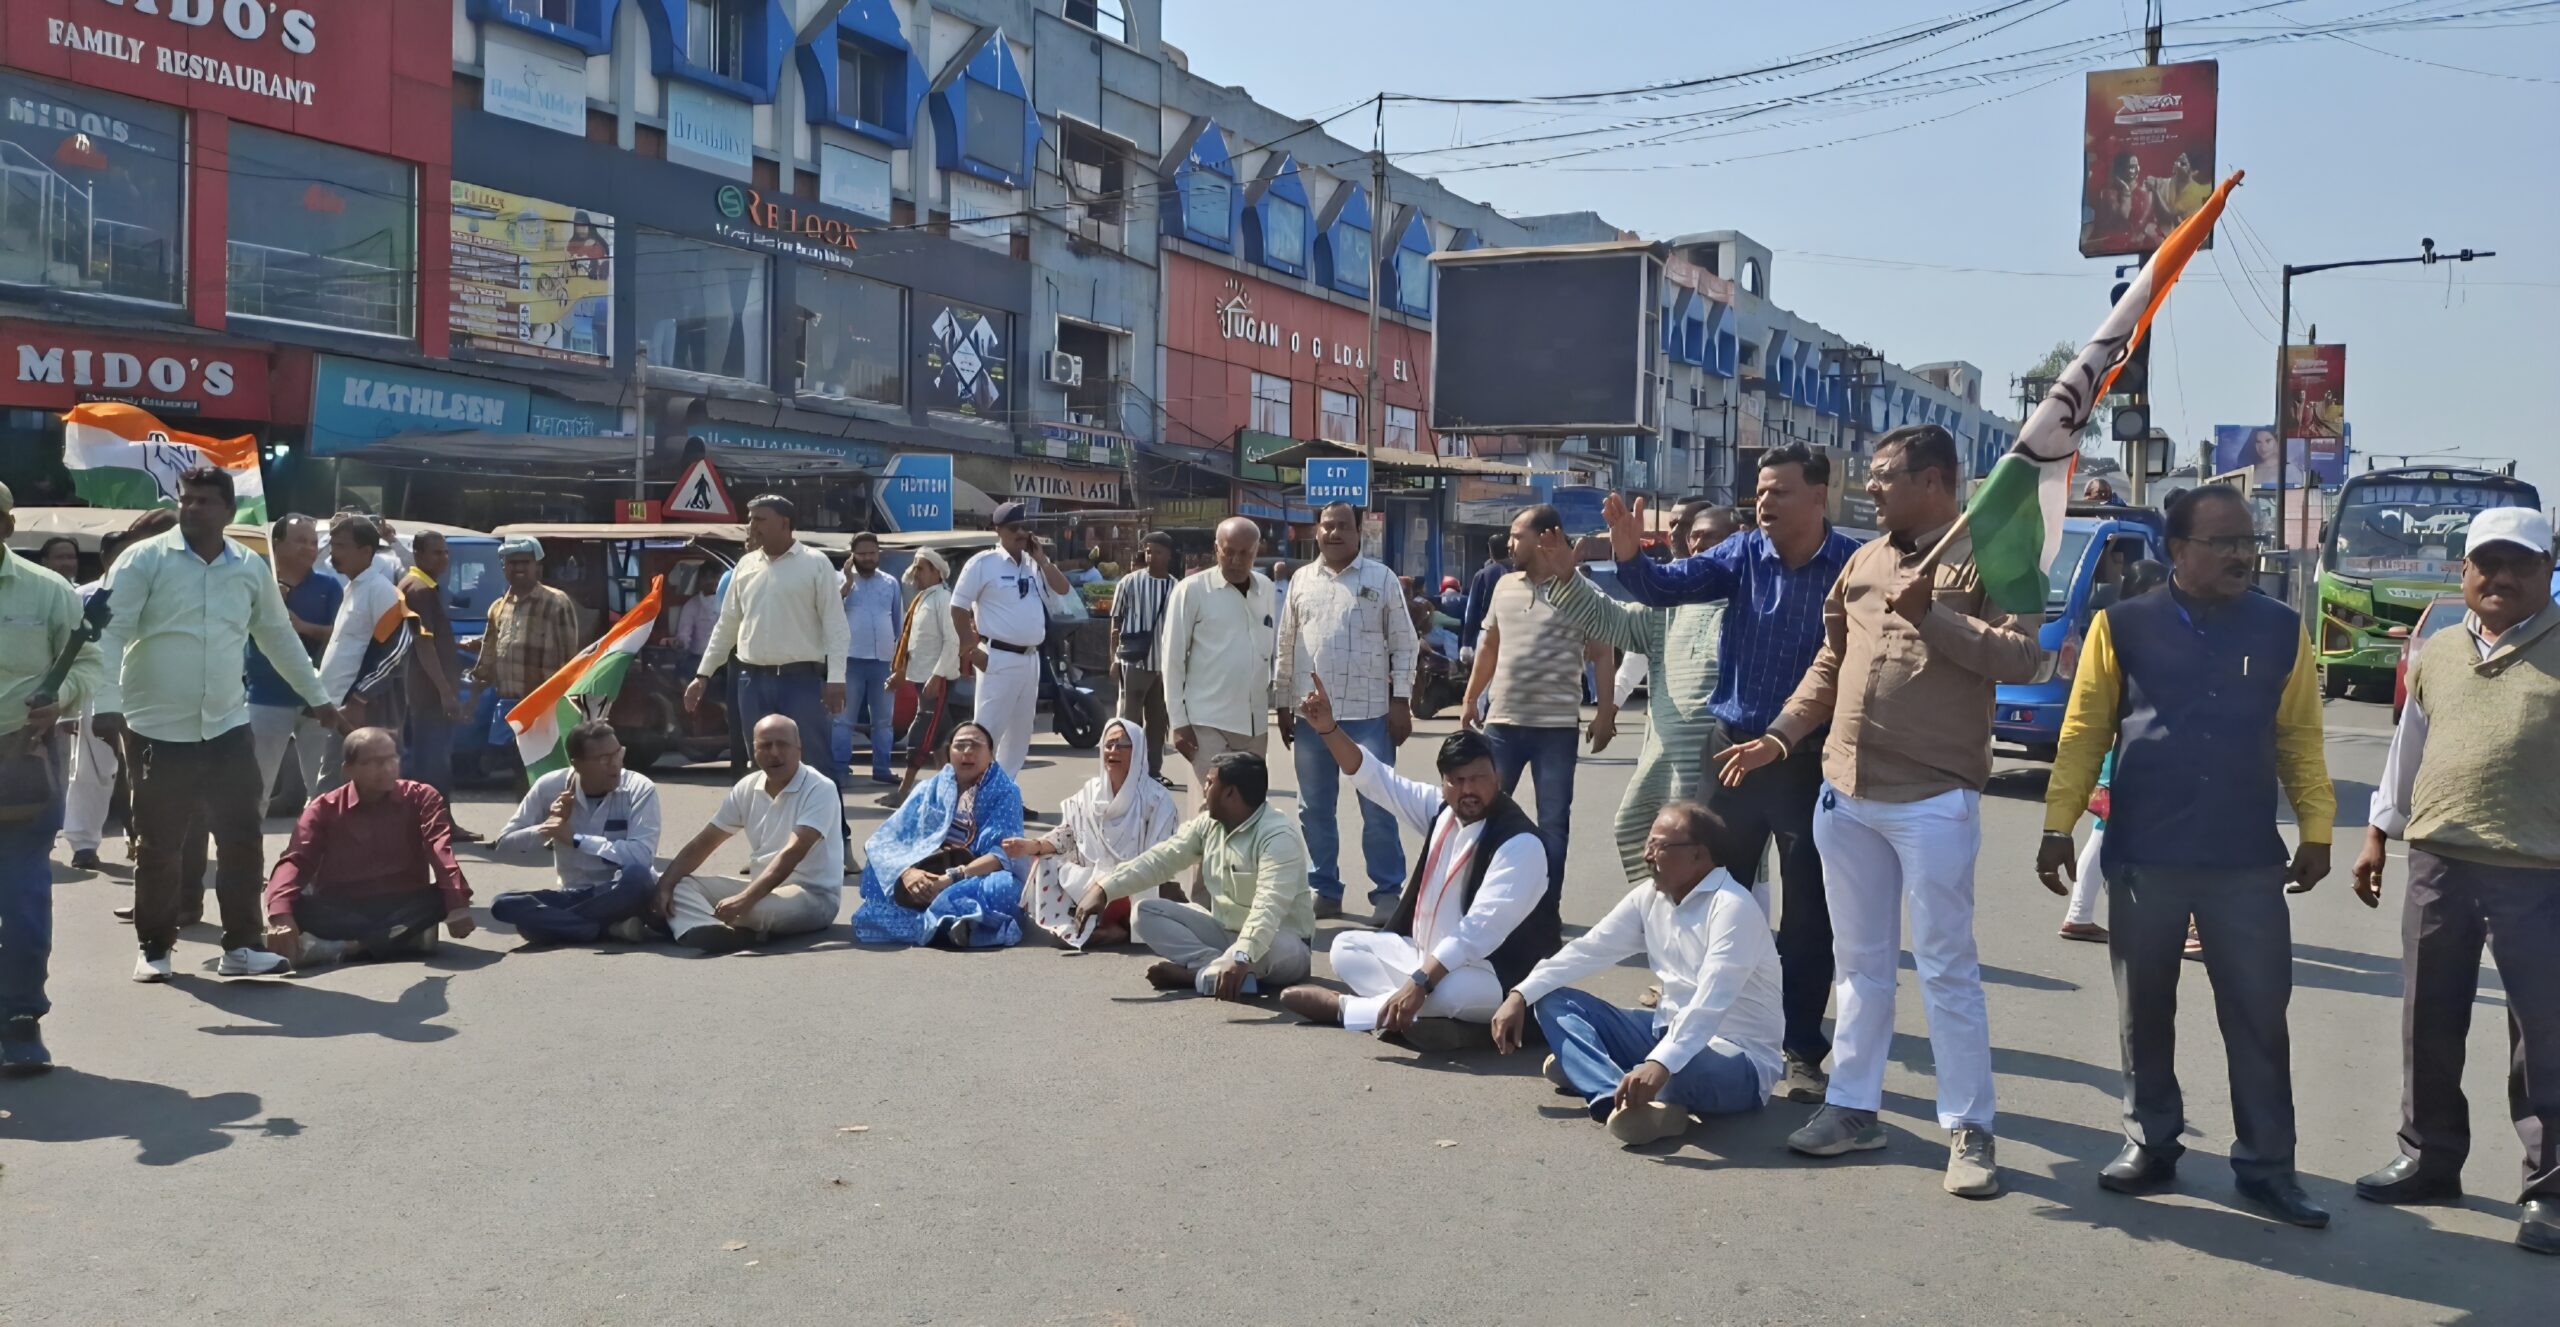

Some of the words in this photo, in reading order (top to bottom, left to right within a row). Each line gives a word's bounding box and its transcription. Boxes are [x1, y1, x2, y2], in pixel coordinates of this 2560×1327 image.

[105, 0, 316, 54] DO'S
[48, 18, 145, 64] FAMILY
[156, 46, 316, 105] RESTAURANT
[17, 344, 234, 396] MIDO'S
[343, 377, 505, 426] KATHLEEN
